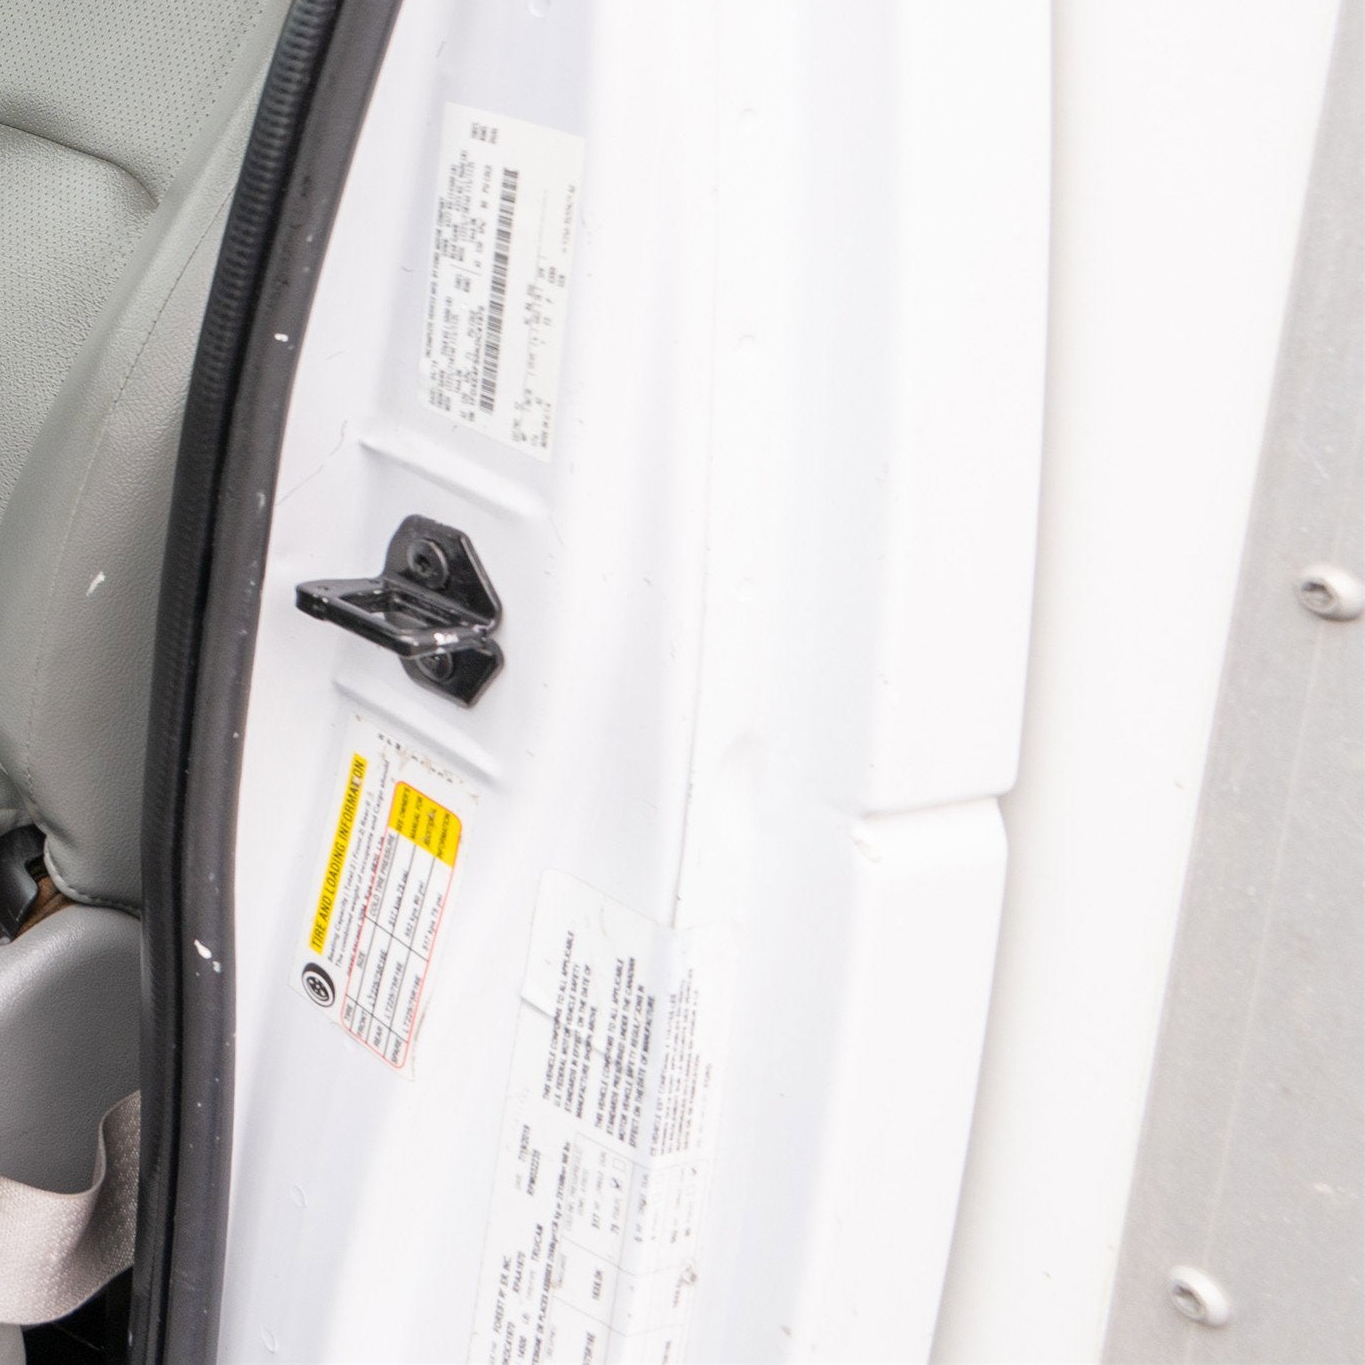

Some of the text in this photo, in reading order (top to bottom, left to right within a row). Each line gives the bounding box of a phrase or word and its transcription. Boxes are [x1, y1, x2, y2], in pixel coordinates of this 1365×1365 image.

[378, 758, 390, 788] should
[373, 789, 384, 815] Cargo
[369, 814, 377, 830] and
[311, 758, 364, 951] TIRE AND LOADING INFORMATON
[334, 896, 347, 932] Capacity
[344, 868, 354, 891] Total
[353, 834, 362, 859] Front
[360, 806, 369, 827] Rear
[359, 831, 374, 875] occupants
[369, 892, 380, 917] COLD
[376, 876, 384, 892] TIRE
[380, 832, 394, 875] PRESSURE
[349, 883, 361, 913] weight
[339, 912, 352, 952] combined
[335, 952, 343, 968] The
[563, 1067, 576, 1112] STANDARDS
[580, 977, 590, 998] DATE
[544, 1050, 556, 1082] VEHICLE
[555, 1057, 567, 1091] FEDERAL
[574, 1063, 589, 1119] MANUFACTURE
[597, 1080, 608, 1110] VEHICLE
[621, 1080, 632, 1112] VEHICLE
[605, 1089, 618, 1135] STANDARDS
[617, 1113, 628, 1141] MOTOR
[628, 1117, 639, 1148] EFFECT
